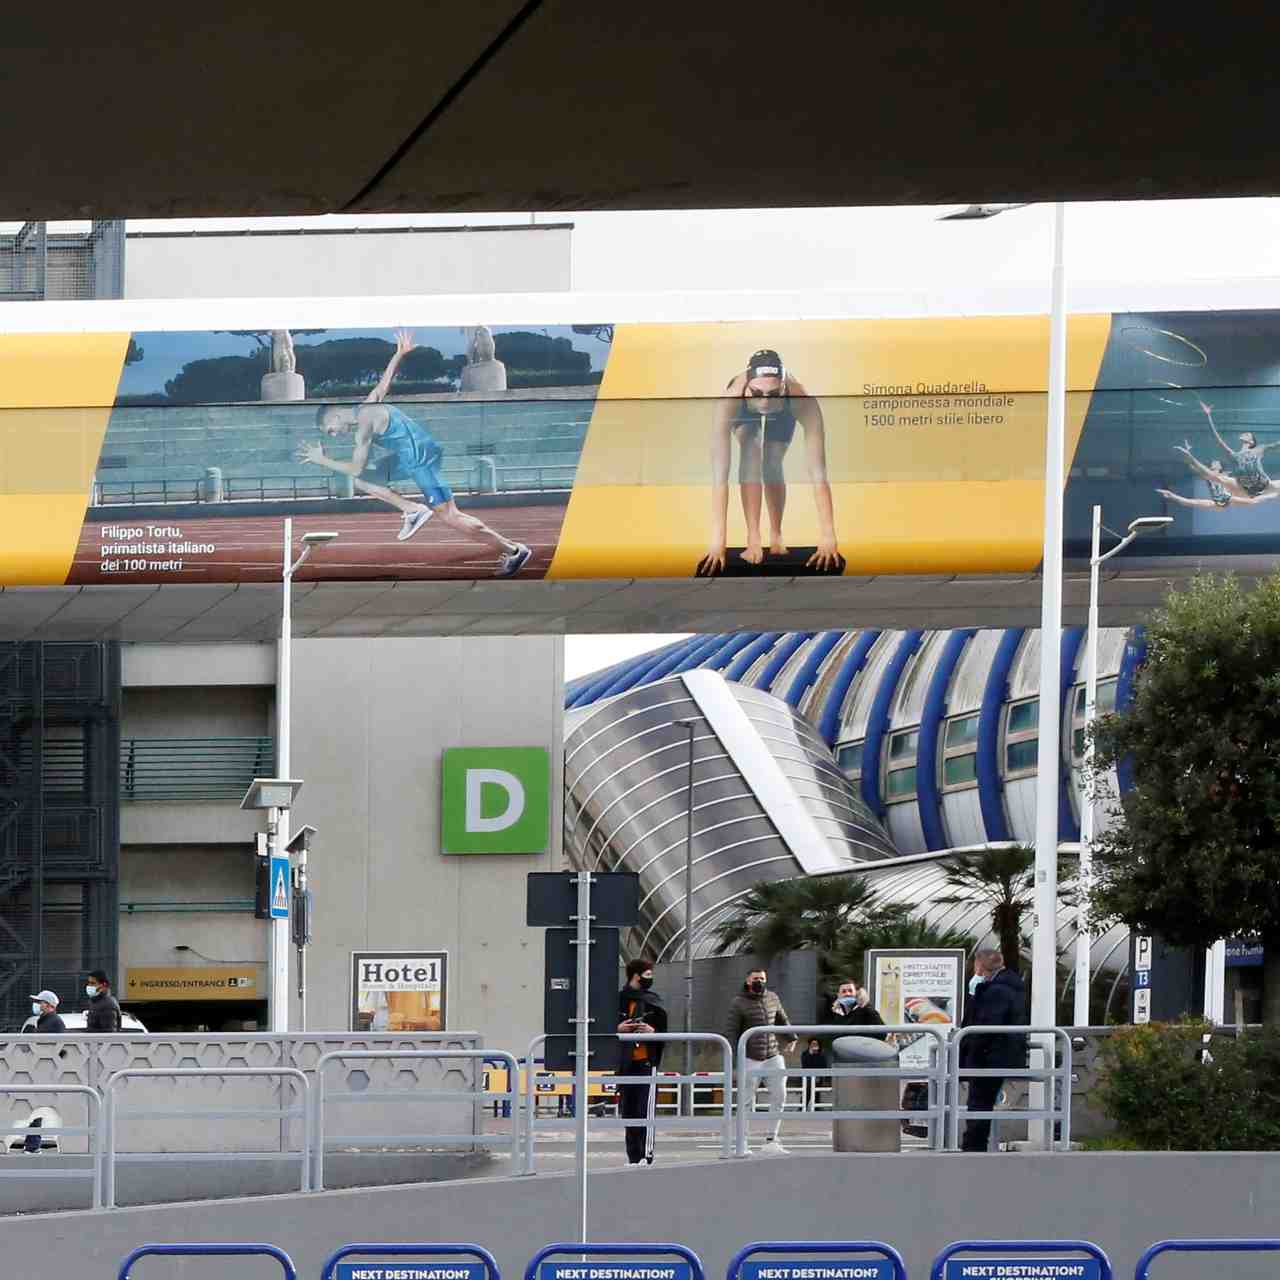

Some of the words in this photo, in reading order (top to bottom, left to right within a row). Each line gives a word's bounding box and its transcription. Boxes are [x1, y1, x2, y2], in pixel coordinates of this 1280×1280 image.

[863, 383, 912, 396] Simona
[863, 396, 950, 410] campionessa
[954, 394, 1014, 408] mondiale
[864, 414, 895, 426] 1500
[899, 414, 932, 426] metri
[937, 413, 964, 426] stile
[101, 526, 143, 540] Filippo
[147, 525, 183, 539] Tortu,
[101, 541, 165, 558] primatista
[168, 541, 215, 554] italiano
[124, 559, 146, 571] 100
[149, 558, 183, 571] metri
[465, 768, 526, 833] D
[362, 962, 438, 982] Hotel
[1139, 971, 1148, 985] T3
[351, 1270, 383, 1280] NEXT
[385, 1269, 470, 1280] DESTINATION?
[556, 1269, 587, 1279] NEXT
[590, 1269, 675, 1279] DESTINATION?
[758, 1268, 789, 1279] NEXT
[792, 1268, 879, 1278] DESTINATION?
[962, 1266, 995, 1276] NEXT
[997, 1266, 1084, 1276] DESTINATION?
